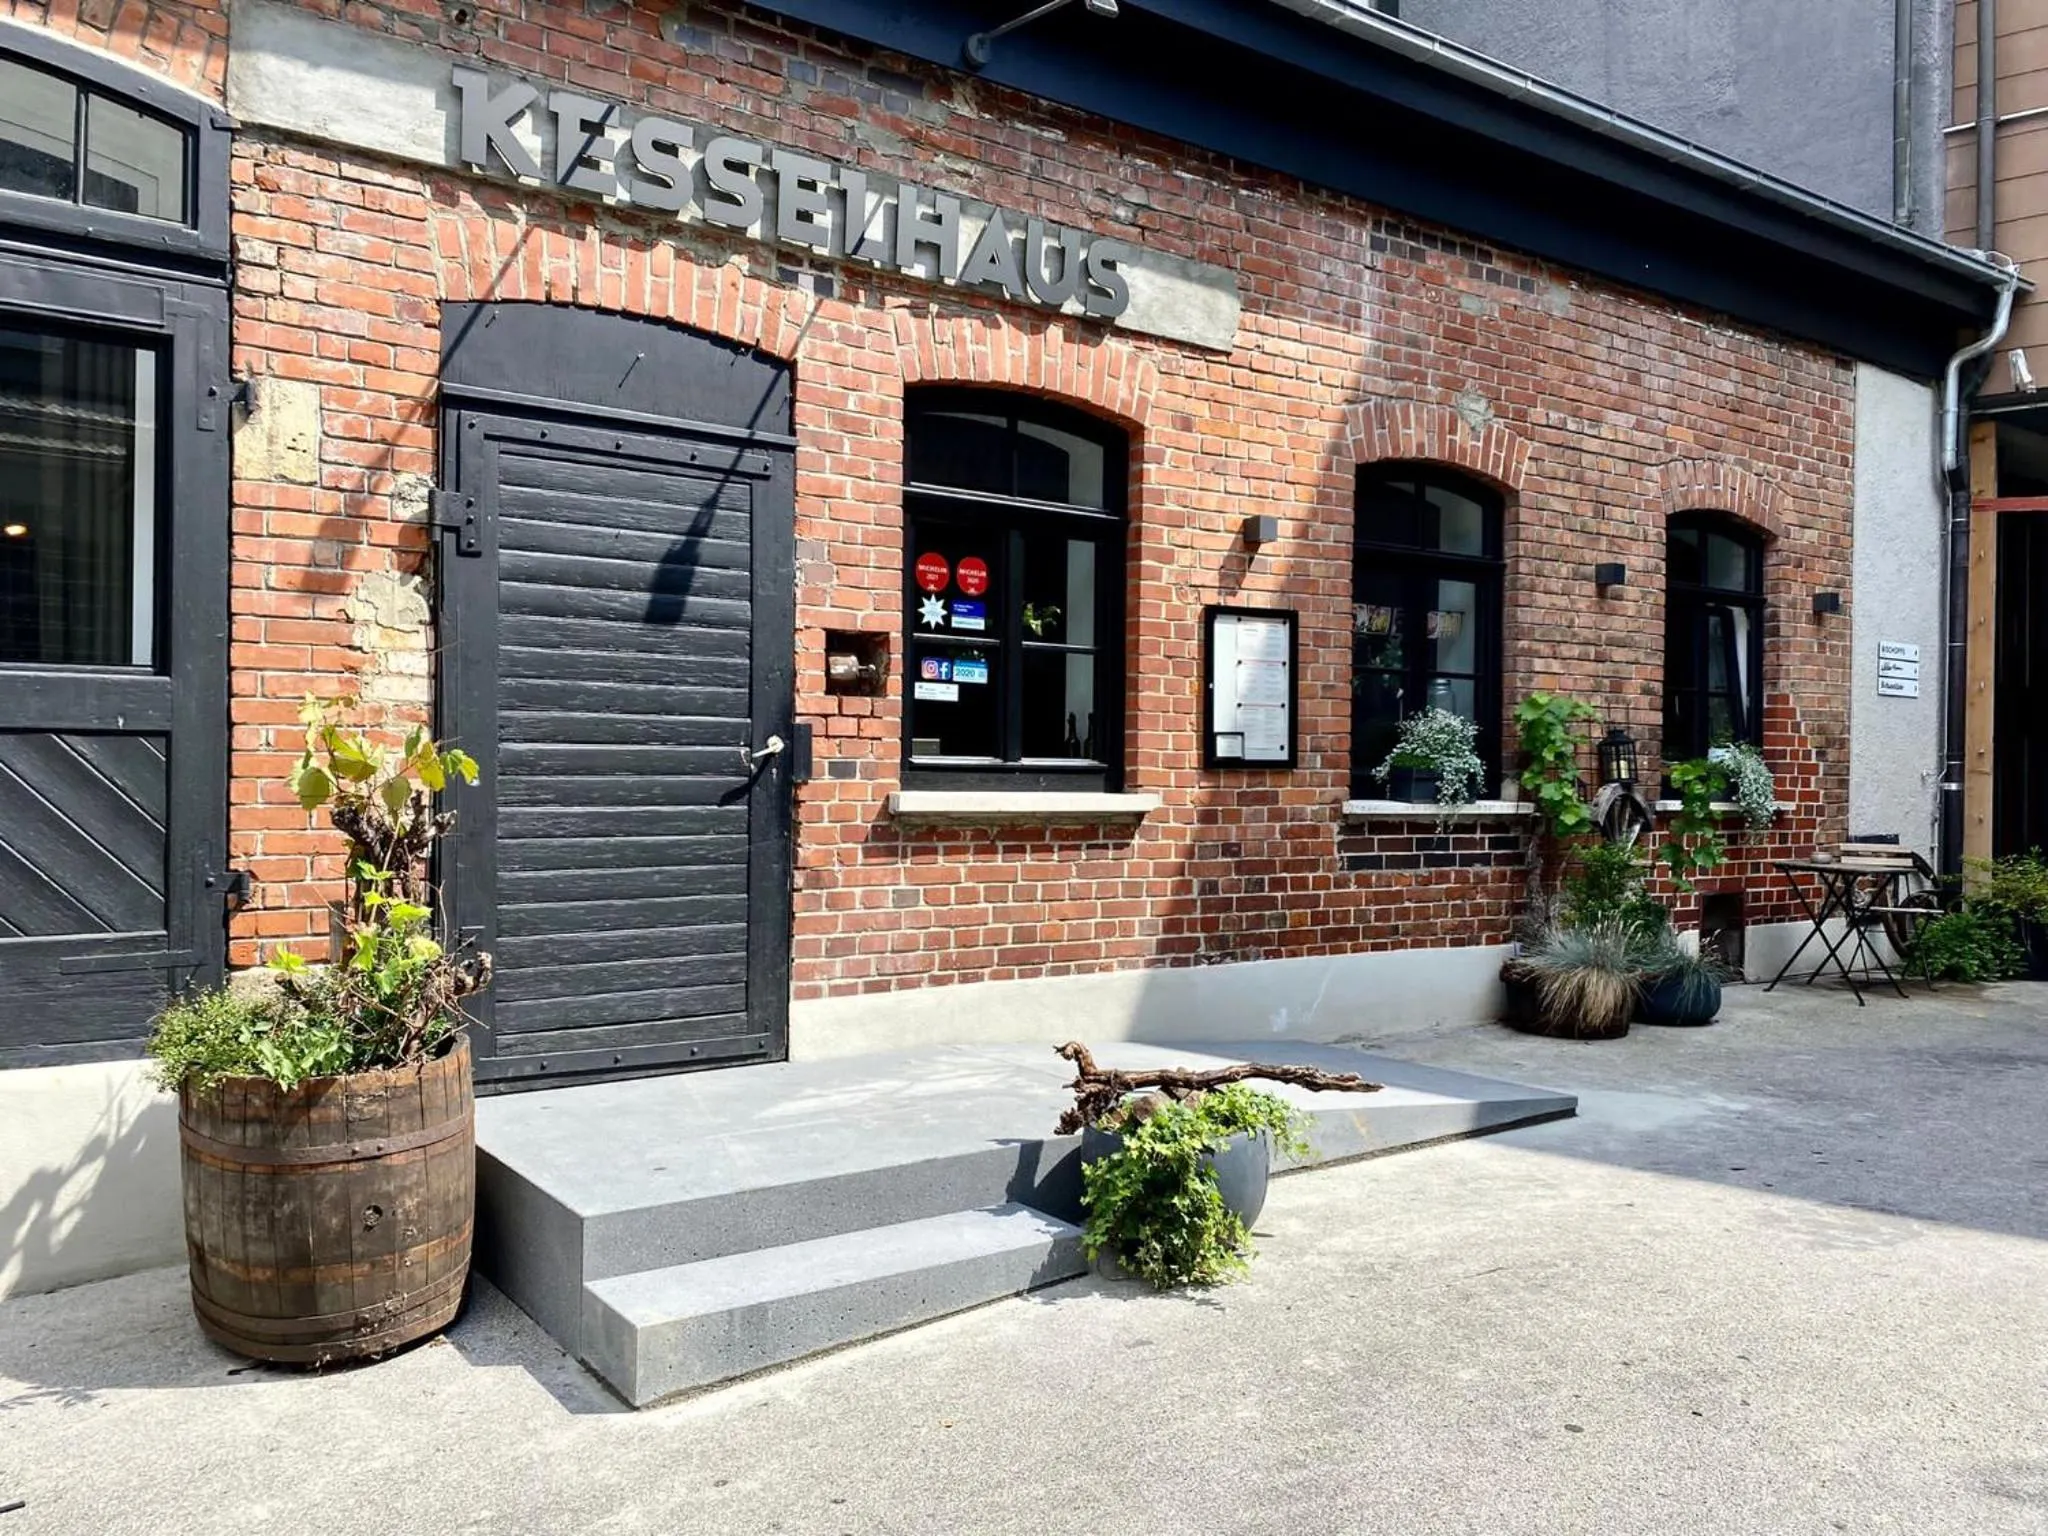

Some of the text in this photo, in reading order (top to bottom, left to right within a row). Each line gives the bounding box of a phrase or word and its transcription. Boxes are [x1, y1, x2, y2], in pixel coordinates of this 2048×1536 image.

[452, 63, 1130, 317] KESSELHAUS
[918, 563, 948, 573] MICHELIN
[959, 567, 987, 577] MICHELIN
[955, 666, 976, 678] 2020
